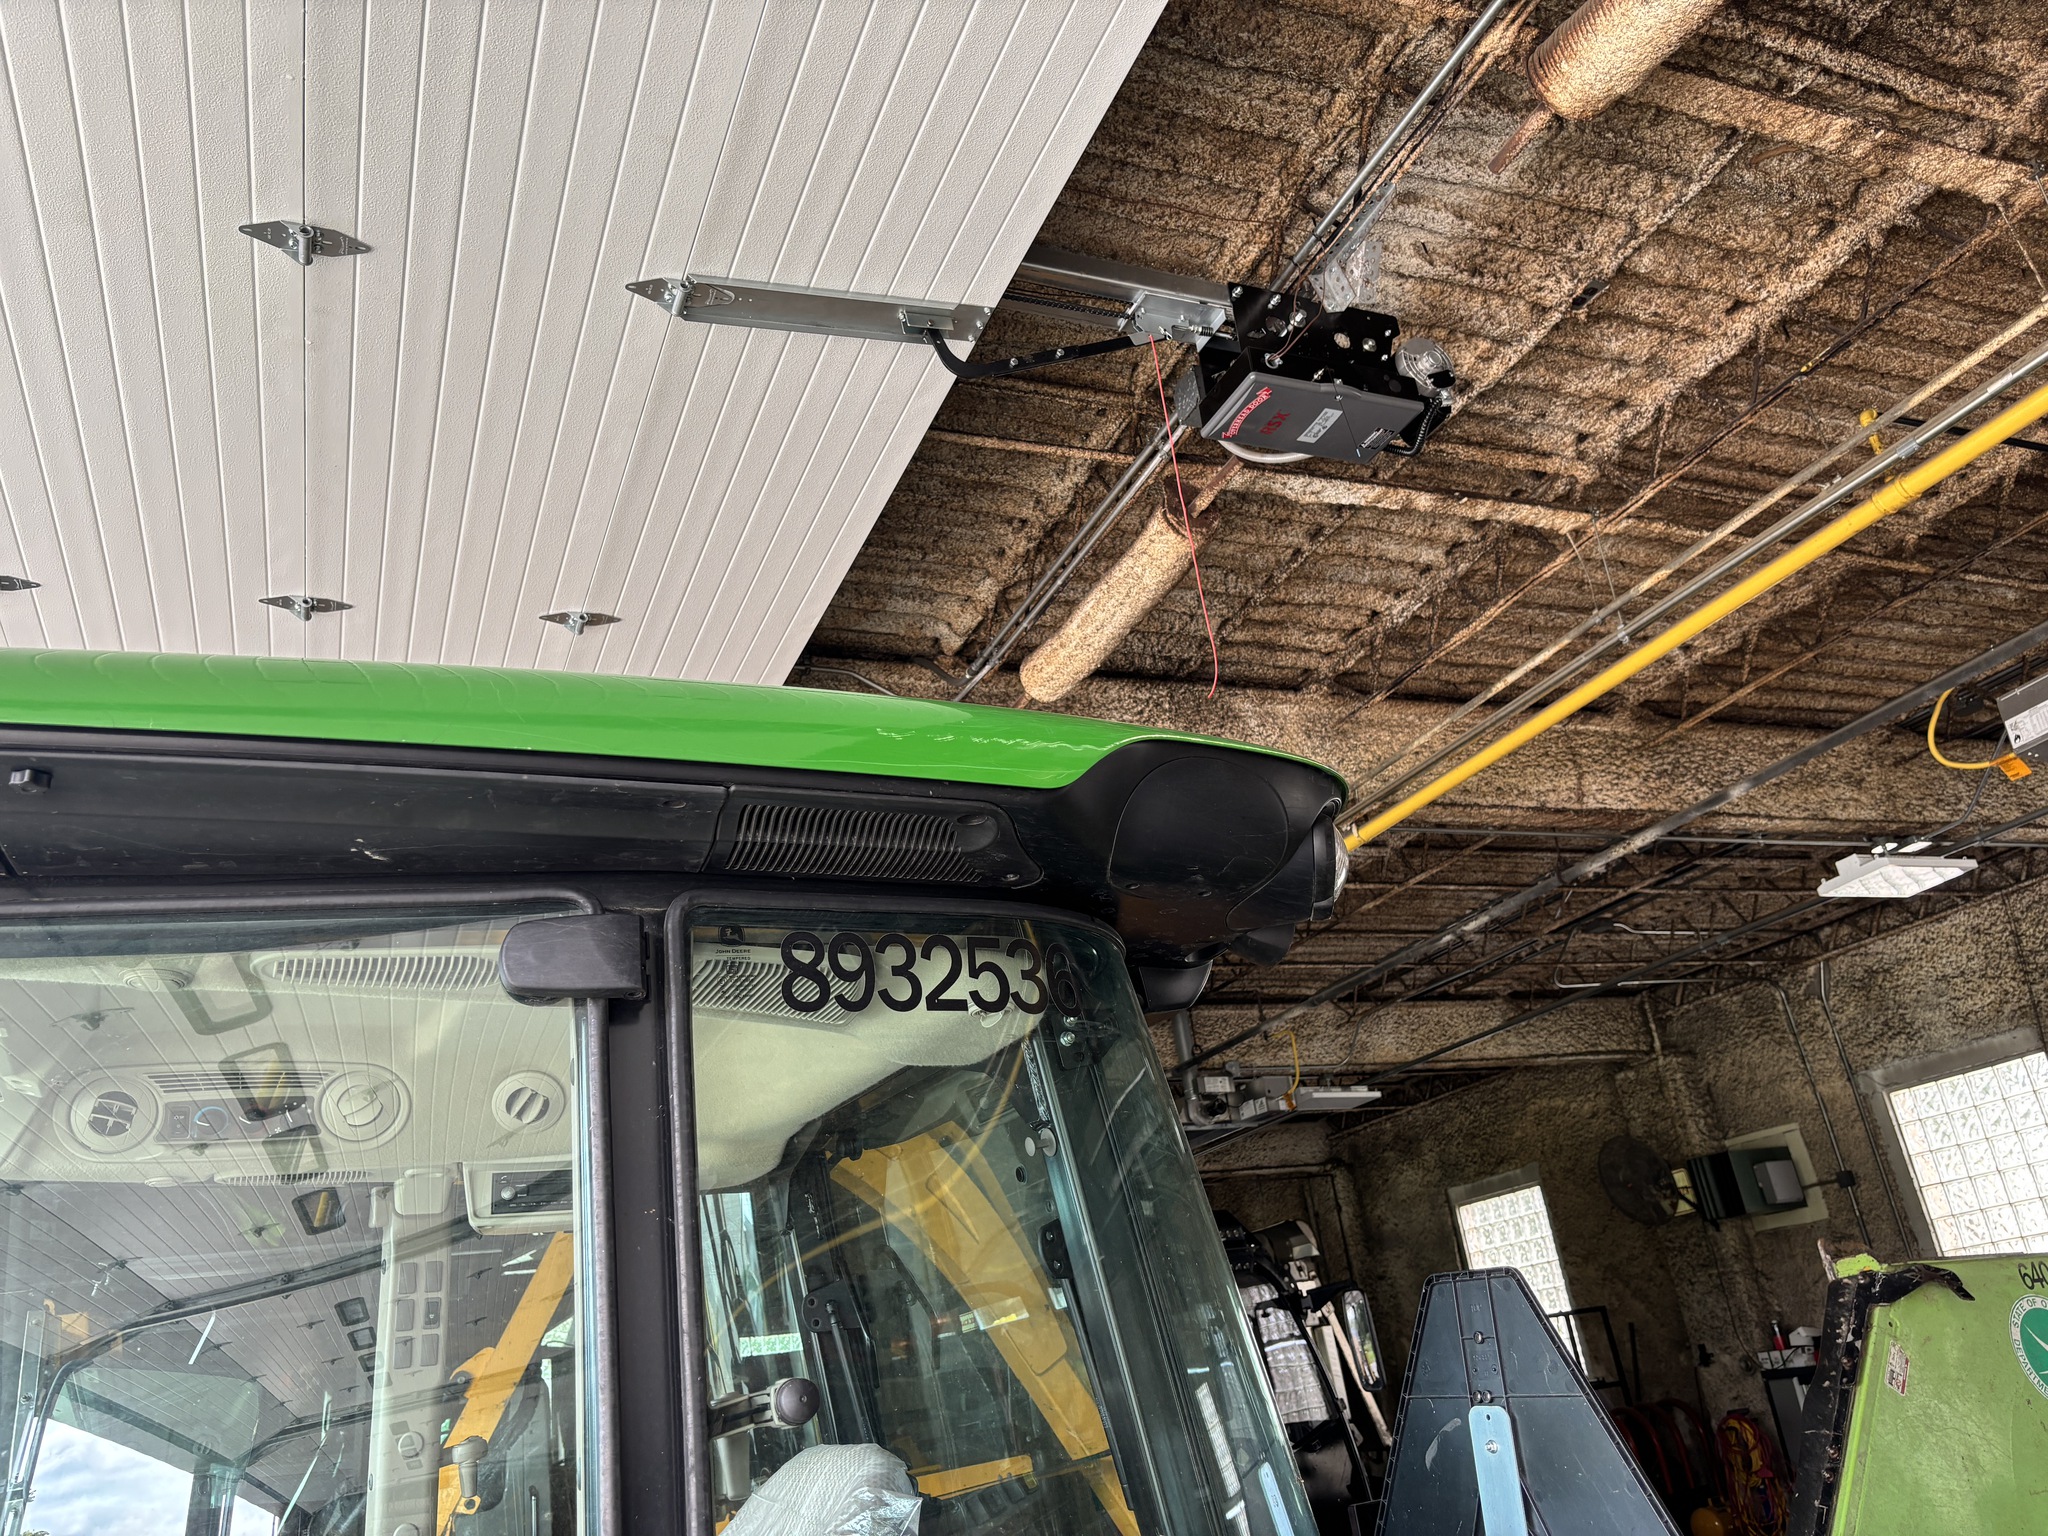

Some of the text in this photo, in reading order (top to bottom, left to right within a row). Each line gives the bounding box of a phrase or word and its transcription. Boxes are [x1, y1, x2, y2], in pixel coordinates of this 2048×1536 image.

[1260, 409, 1290, 435] RSX
[780, 931, 1083, 1017] 8932536
[2012, 1303, 2027, 1329] STATE
[2026, 1298, 2037, 1308] OF
